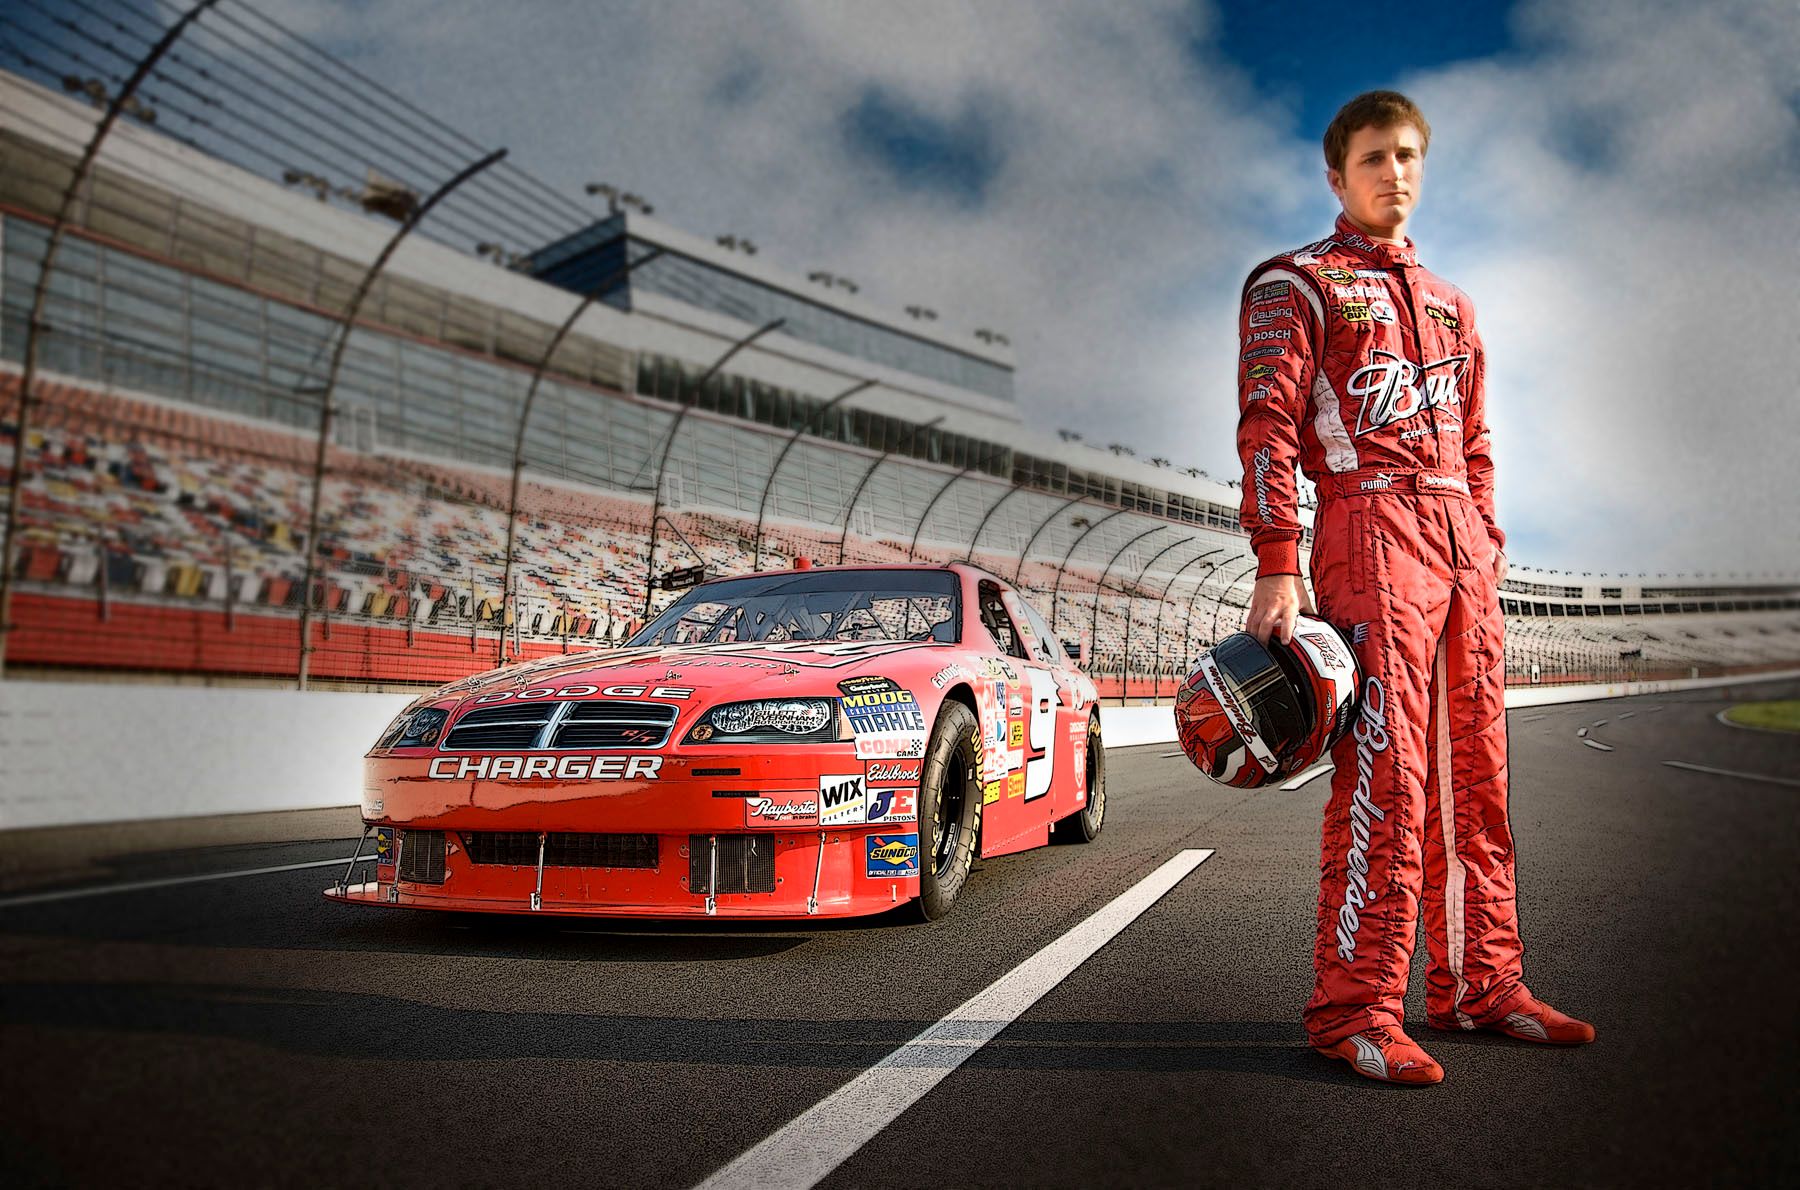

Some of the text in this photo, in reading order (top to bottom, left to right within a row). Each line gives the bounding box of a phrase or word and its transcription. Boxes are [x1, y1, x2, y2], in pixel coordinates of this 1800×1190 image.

[1344, 232, 1377, 252] Bud
[1347, 312, 1367, 320] BUY
[1253, 329, 1291, 341] BOSCH
[1360, 480, 1389, 491] PUMA
[475, 685, 696, 704] DODGE
[841, 690, 913, 709] MOOG
[1209, 664, 1257, 744] Budweiser
[848, 712, 925, 734] MAHLE
[622, 729, 657, 743] R/T
[1024, 666, 1064, 803] 9
[859, 739, 911, 754] COMP
[427, 756, 664, 780] CHARGER
[867, 763, 920, 782] Edelbrock
[821, 777, 863, 808] WIX
[822, 804, 864, 823] FILTERS
[867, 789, 914, 820] JE
[1337, 676, 1389, 963] Budweiser
[871, 846, 917, 859] SUNOCO
